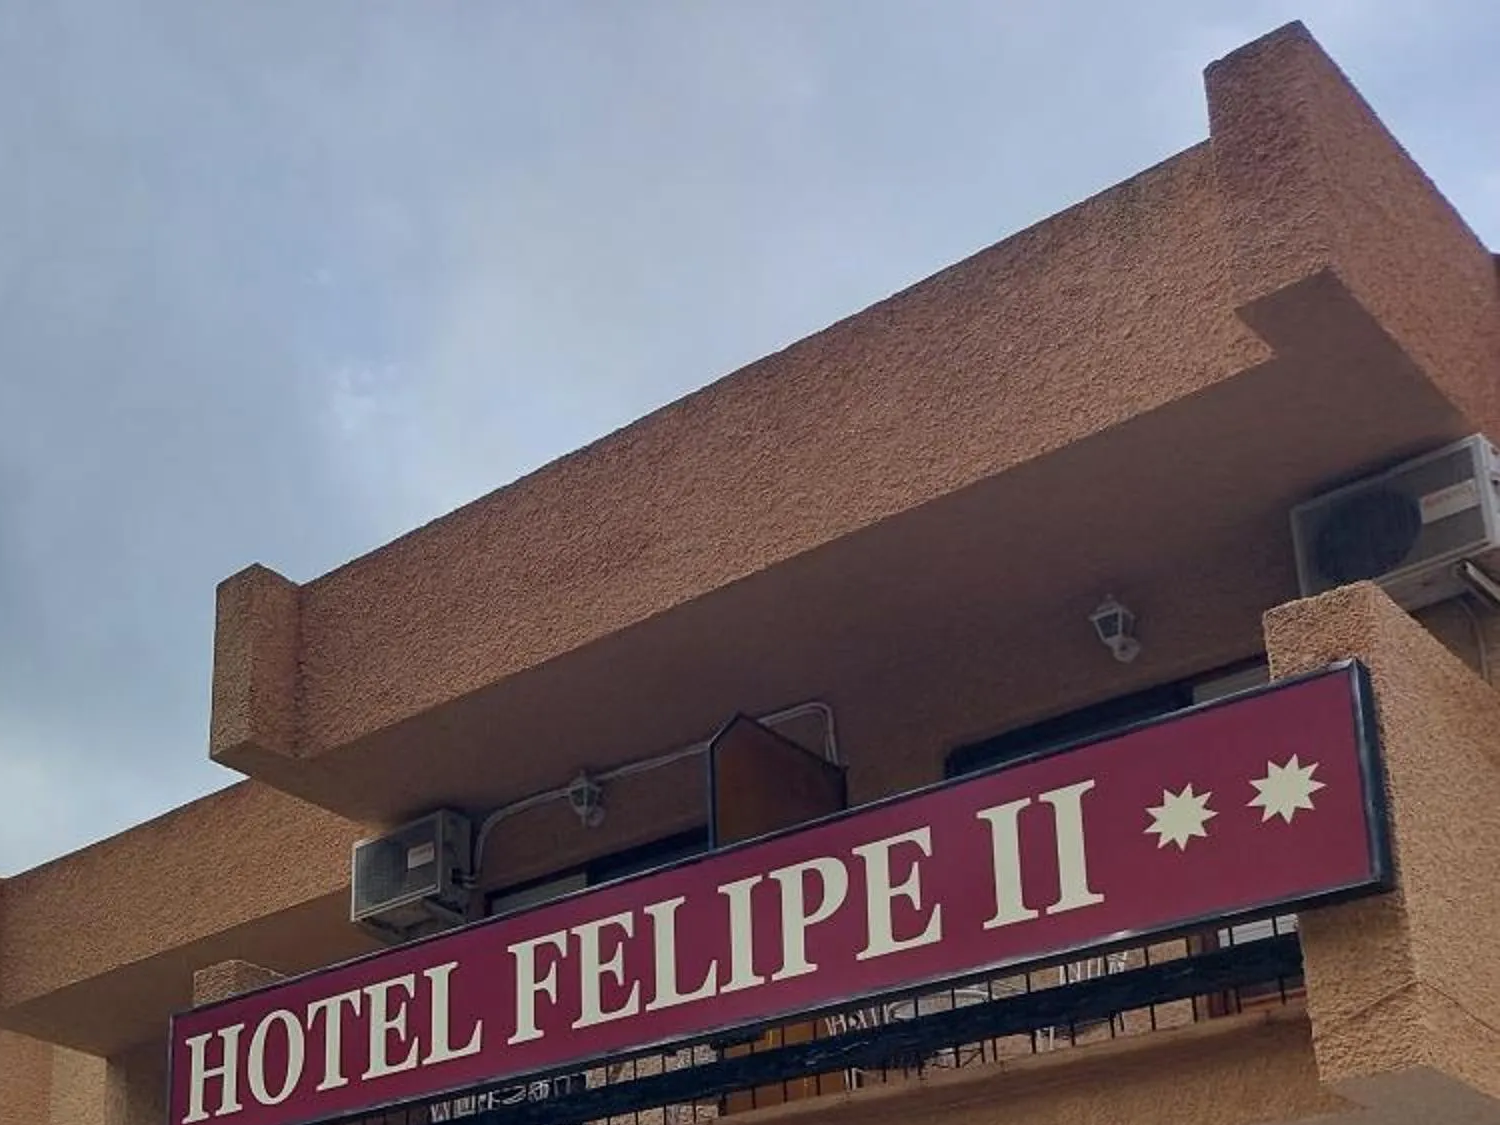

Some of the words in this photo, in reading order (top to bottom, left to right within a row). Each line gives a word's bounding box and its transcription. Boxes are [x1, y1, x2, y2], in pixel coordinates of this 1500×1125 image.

[181, 960, 483, 1125] HOTEL
[506, 826, 942, 1046] FELIPE
[975, 779, 1105, 930] II
